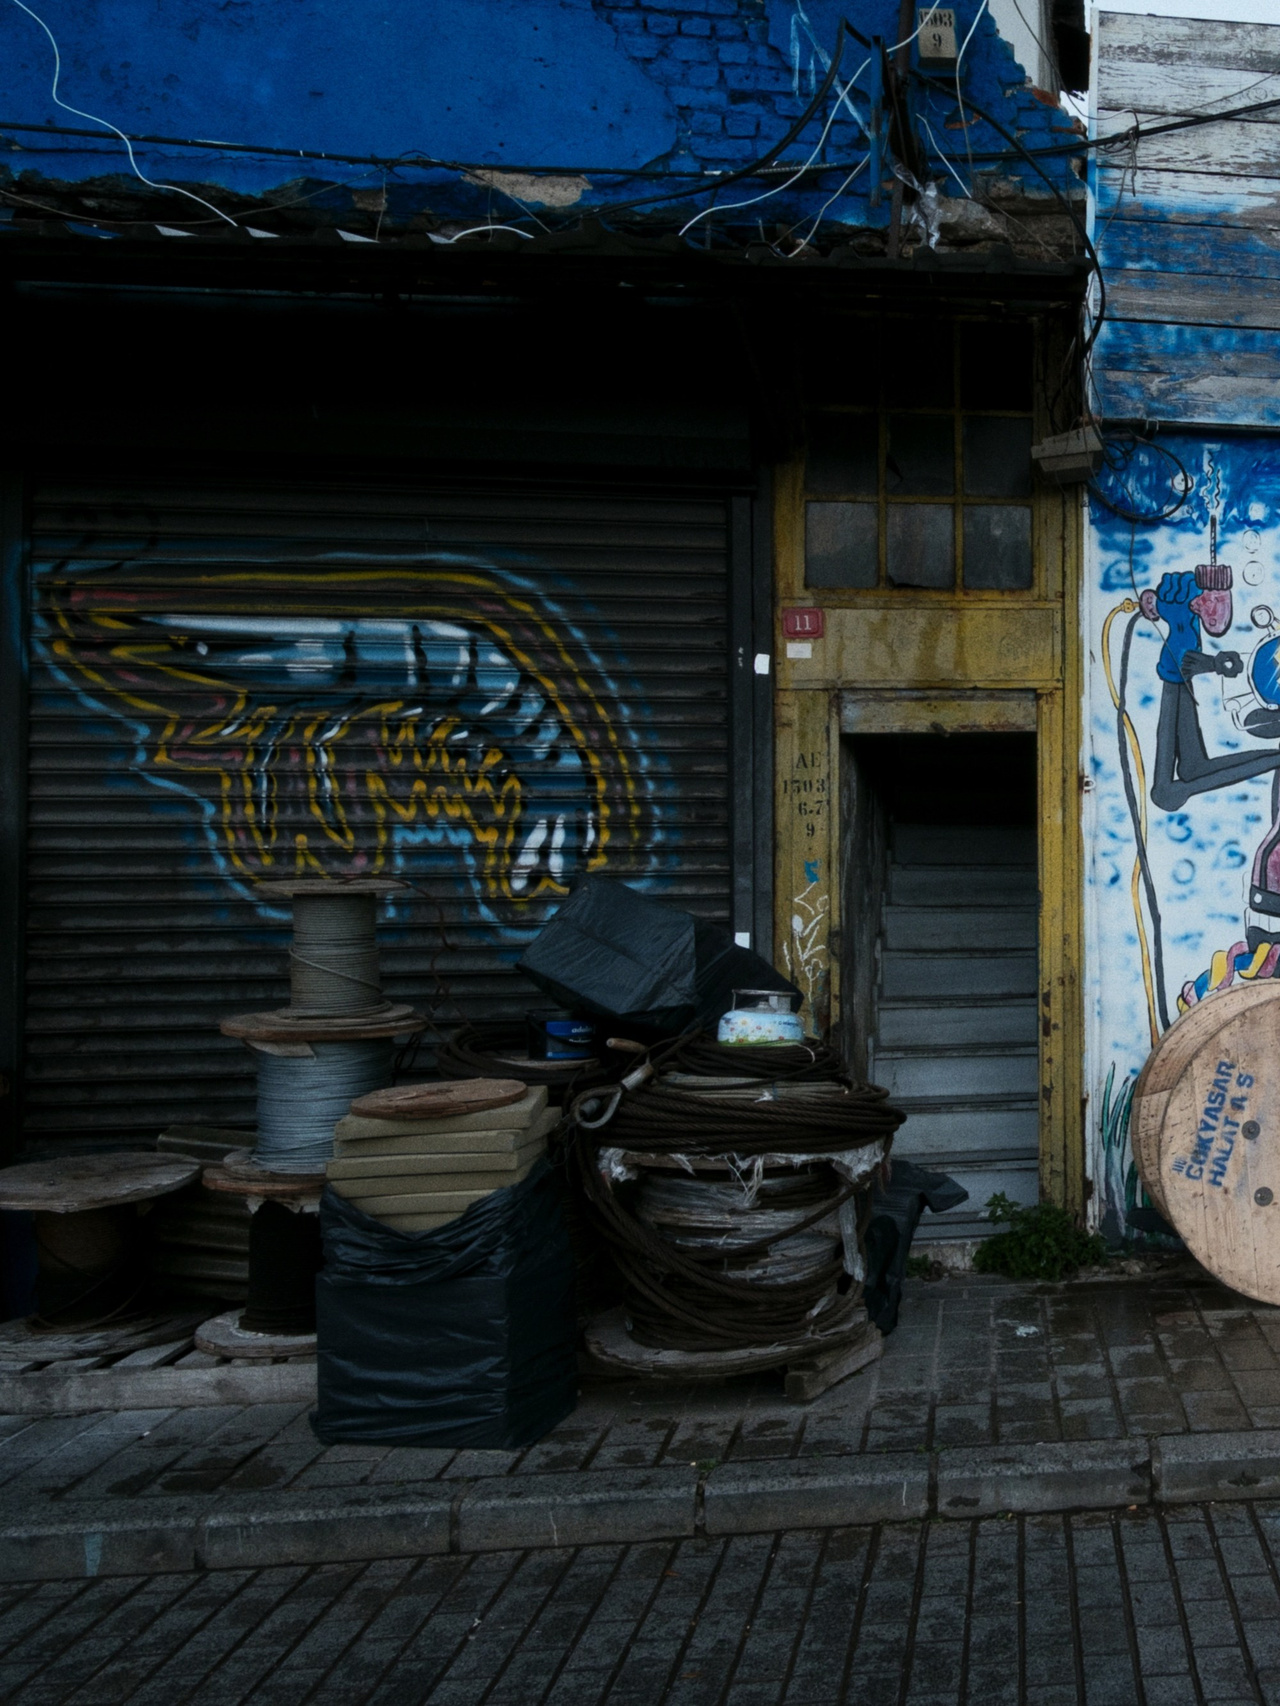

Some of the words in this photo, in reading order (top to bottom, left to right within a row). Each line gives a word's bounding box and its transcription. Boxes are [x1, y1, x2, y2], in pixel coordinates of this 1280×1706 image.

[932, 33, 943, 47] 9
[794, 614, 812, 631] 11
[806, 822, 815, 838] 9
[1208, 1115, 1240, 1187] HALAT
